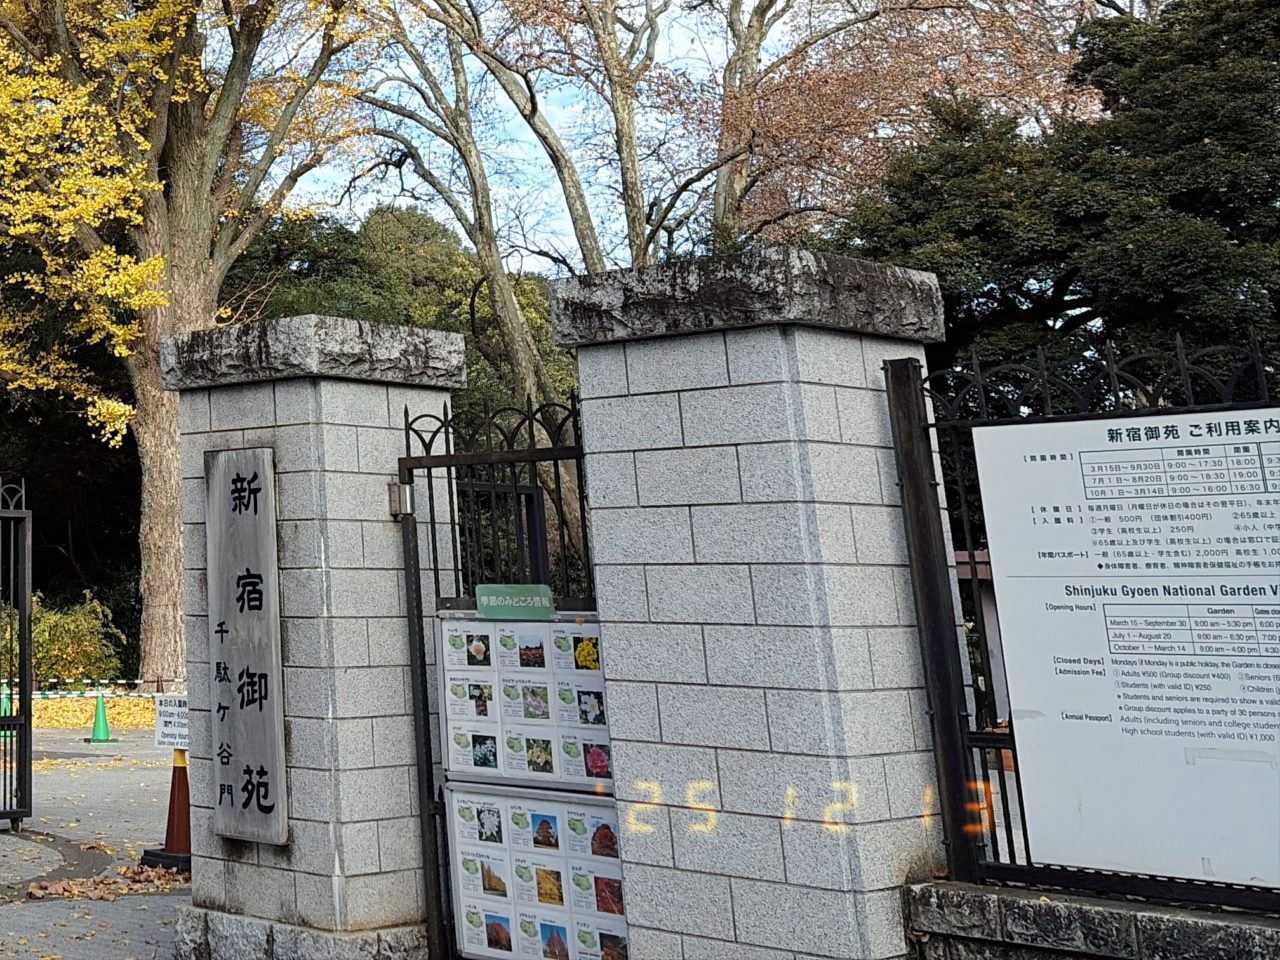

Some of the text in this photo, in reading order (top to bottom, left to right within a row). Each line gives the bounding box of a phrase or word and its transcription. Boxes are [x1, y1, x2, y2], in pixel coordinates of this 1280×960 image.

[1107, 418, 1280, 443] 新宿御苑 ご利用案内
[1231, 458, 1256, 466] 18:00
[1232, 471, 1258, 479] 19:00
[1235, 483, 1260, 491] 16:30
[1119, 515, 1142, 523] 500円
[1170, 525, 1195, 533] 250円
[1064, 585, 1117, 598] Shinjuku
[1121, 585, 1159, 598] Gyoen
[1162, 584, 1216, 596] National
[1220, 584, 1266, 596] Garden
[480, 595, 551, 608] 季節のみどころ情報
[1207, 607, 1235, 615] Garden
[1242, 621, 1252, 629] pm
[230, 471, 276, 815] 新宿御苑
[1113, 643, 1139, 651] October
[1111, 658, 1137, 667] Mondays
[1144, 659, 1168, 667] Monday
[1232, 661, 1255, 669] Garden
[1159, 671, 1182, 679] (Group
[1122, 692, 1150, 700] Students
[1124, 704, 1144, 712] Group
[1145, 705, 1171, 713] discount
[1211, 708, 1228, 716] party
[1229, 708, 1237, 716] of
[1248, 710, 1276, 718] persons
[1120, 715, 1142, 724] Adults
[1144, 716, 1179, 726] (including
[1208, 719, 1222, 727] and
[1224, 720, 1251, 730] college
[1121, 727, 1138, 736] High
[1140, 728, 1163, 736] school
[1164, 730, 1196, 738] students
[1197, 730, 1216, 739] (with
[1217, 731, 1236, 740] valid
